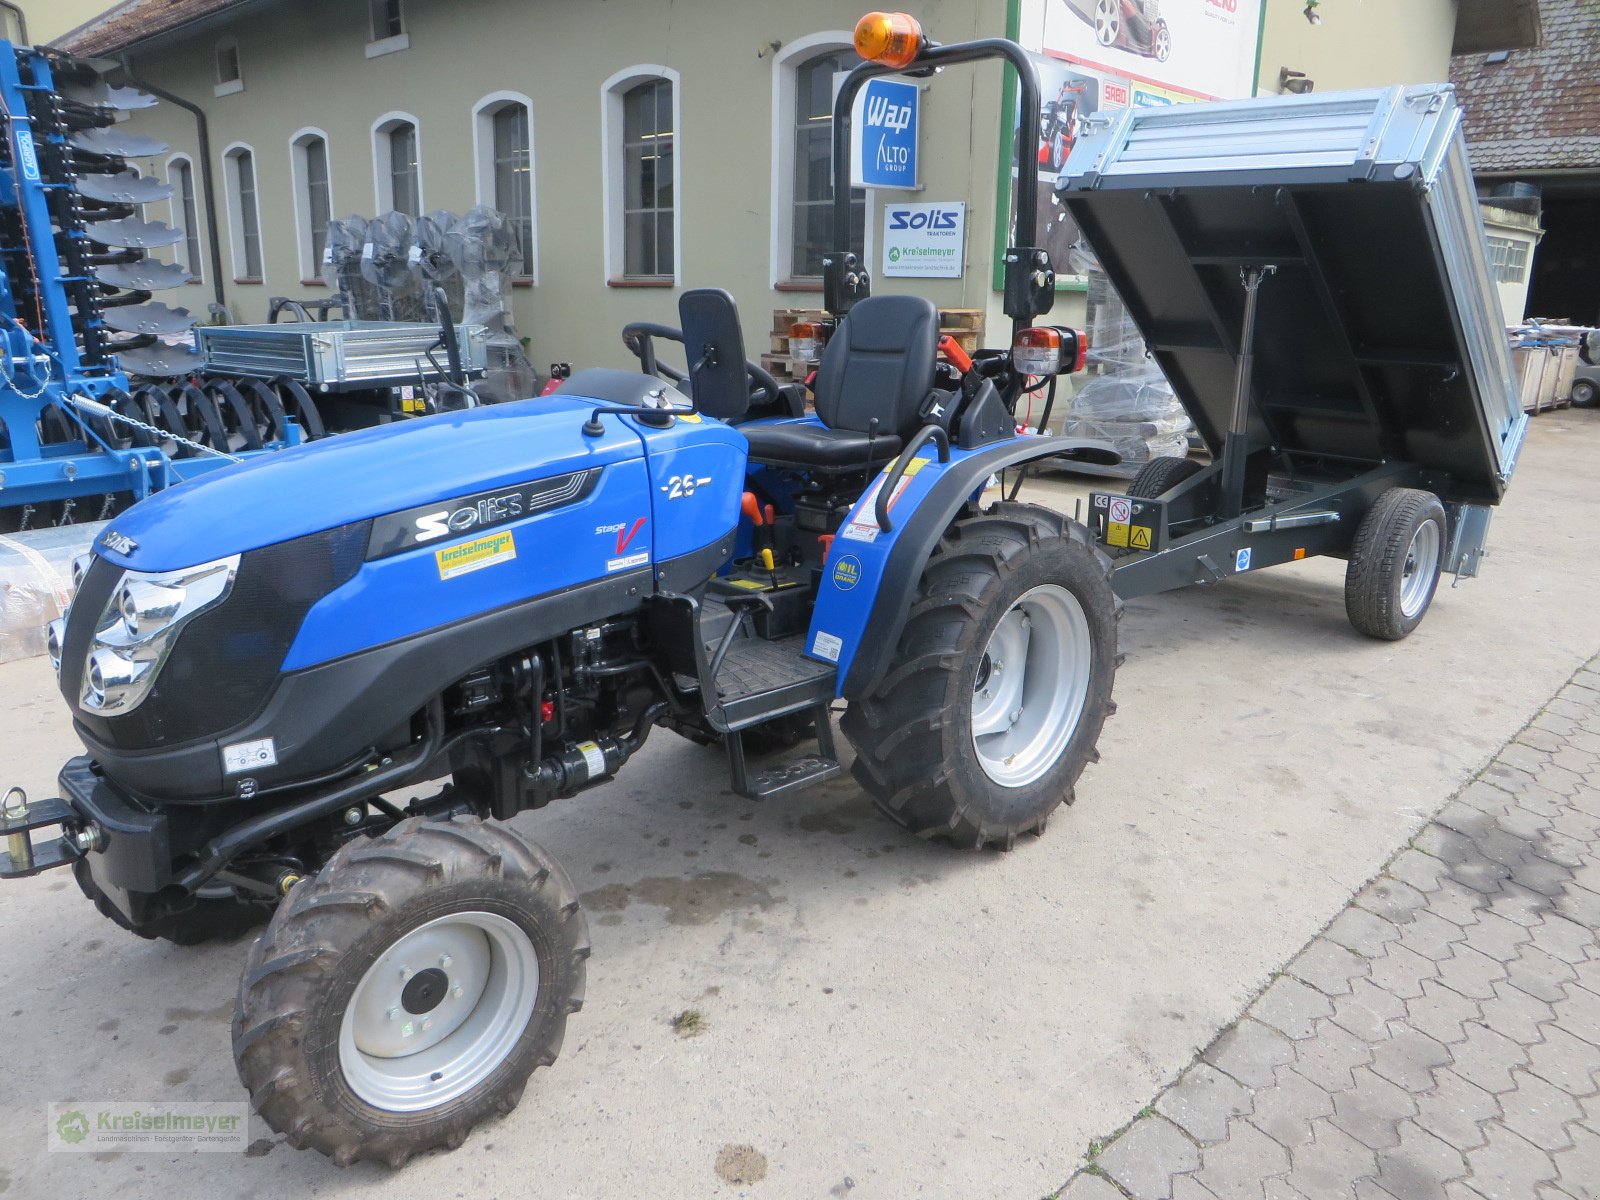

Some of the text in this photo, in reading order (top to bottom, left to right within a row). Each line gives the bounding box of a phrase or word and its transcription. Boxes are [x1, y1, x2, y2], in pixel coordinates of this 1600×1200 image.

[1104, 85, 1127, 105] SABO
[866, 95, 912, 135] Wap
[876, 133, 908, 171] ALTO
[885, 164, 907, 172] GROUP
[902, 246, 956, 258] Kreiselmeyer
[668, 474, 695, 501] 26
[1095, 496, 1108, 507] CE
[594, 522, 627, 535] Stage
[615, 516, 648, 554] V
[441, 534, 511, 562] kreiselmeyer
